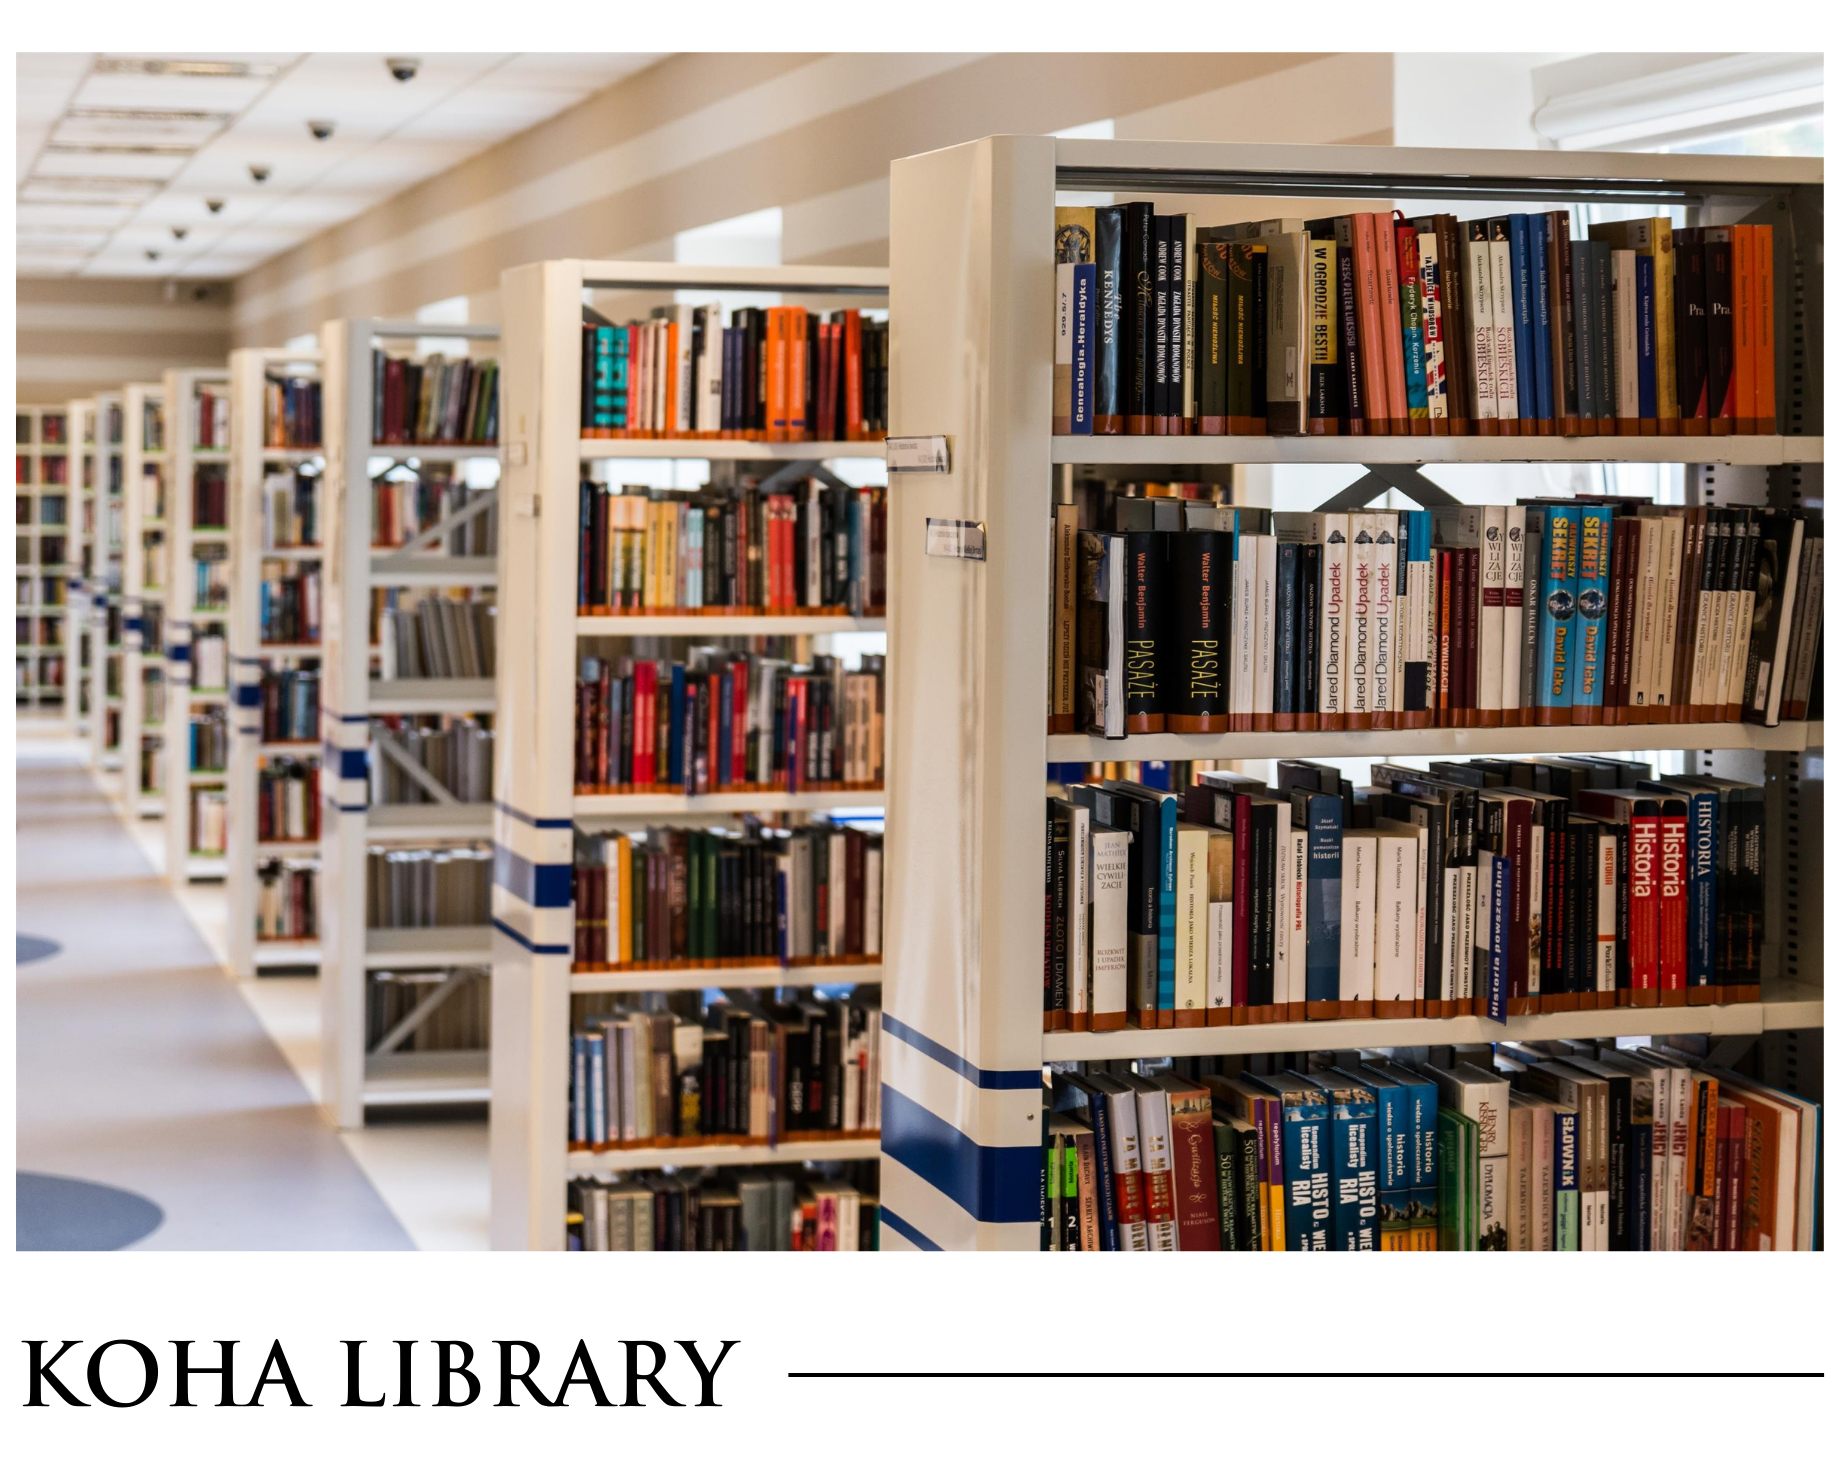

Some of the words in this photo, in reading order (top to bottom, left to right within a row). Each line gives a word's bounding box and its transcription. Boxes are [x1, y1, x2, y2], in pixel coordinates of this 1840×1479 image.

[1314, 247, 1327, 259] W
[1314, 262, 1328, 320] OGRODZIE
[1386, 268, 1394, 304] Stuartowie
[1424, 256, 1435, 292] TAJEMNICE
[1104, 270, 1113, 344] KENNEDYS
[1343, 282, 1354, 311] PIĘTER
[1407, 276, 1416, 310] Fryderyk
[1521, 283, 1529, 324] Bonapartych
[1540, 284, 1548, 325] Bonapartych
[1345, 312, 1356, 346] LUKSUSU
[1409, 312, 1419, 339] Chopin.
[1427, 297, 1437, 336] WINDSORÓW
[1076, 278, 1087, 422] Genealogia.Heraldyka
[1314, 324, 1328, 360] BESTII
[1412, 342, 1420, 375] Korzenie
[1476, 326, 1488, 399] SOBIESKICH
[1497, 326, 1509, 399] SOBIESKICH
[1488, 543, 1501, 551] WI
[1489, 552, 1500, 561] LI
[1510, 543, 1523, 552] WI
[1512, 553, 1521, 561] LI
[1550, 516, 1569, 581] SEKRET
[1567, 522, 1577, 578] NAJWIĘKSZY
[1581, 516, 1600, 581] SEKRET
[1598, 521, 1609, 578] NAJWIĘKSZY
[1137, 552, 1145, 582] Walter
[1202, 552, 1210, 582] Walter
[1486, 572, 1502, 582] CJE
[1488, 562, 1501, 571] ZA
[1508, 572, 1523, 582] CJE
[1510, 562, 1522, 571] ZA
[1327, 562, 1343, 614] Upadek
[1355, 562, 1370, 615] Upadek
[1376, 562, 1392, 614] Upadek
[1528, 579, 1537, 606] OSKAR
[1136, 585, 1147, 629] Benjamin
[1200, 585, 1211, 629] Benjamin
[1701, 592, 1709, 622] GRANICE
[1728, 592, 1737, 622] GRANICE
[1528, 608, 1537, 644] HALECKI
[1554, 626, 1568, 662] David
[1584, 625, 1599, 662] David
[1698, 624, 1706, 653] HISTORII
[1724, 624, 1733, 653] HISTORII
[1326, 617, 1339, 674] Diamond
[1354, 617, 1367, 675] Diamond
[1375, 617, 1388, 674] Diamond
[1441, 634, 1449, 693] CYWILIZACJE
[1128, 640, 1158, 699] PASAŻE
[1191, 640, 1221, 699] PASAŻE
[1553, 666, 1566, 696] Icke
[1583, 665, 1596, 694] Icke
[1326, 677, 1338, 713] Jared
[1353, 678, 1366, 713] Jared
[1374, 678, 1386, 712] Jared
[1096, 849, 1127, 857] MATHIEX
[1296, 838, 1304, 853] Rafał
[1313, 852, 1339, 860] historii
[1697, 801, 1712, 877] HISTORIA
[1096, 872, 1126, 880] CYWILI-
[1295, 853, 1303, 880] Stobiecki
[1605, 847, 1614, 885] HISTORIA
[1635, 823, 1657, 897] Historia
[1663, 823, 1685, 897] Historia
[1057, 875, 1065, 908] LIEBRICH
[1101, 881, 1122, 889] ZACJE
[1295, 881, 1303, 919] Historiografia
[1294, 919, 1302, 931] PRL
[1493, 861, 1503, 954] powszechna
[1095, 963, 1126, 971] IMPERIÓW
[1491, 957, 1500, 1018] Historia
[1386, 1101, 1394, 1126] wiedza
[1416, 1098, 1424, 1123] wiedza
[1708, 1088, 1717, 1127] HISTORIA
[1123, 1135, 1137, 1152] ZA
[1149, 1135, 1165, 1152] ZA
[1272, 1122, 1281, 1166] repetytorium
[1479, 1101, 1489, 1153] KISSINGER
[1488, 1109, 1497, 1145] HENRY
[1188, 1134, 1203, 1189] Cywilizacja
[1220, 1154, 1232, 1169] 50
[1244, 1139, 1254, 1154] 50
[1300, 1126, 1312, 1170] licealisty
[1310, 1125, 1320, 1169] Kompendium
[1347, 1124, 1359, 1168] licealisty
[1358, 1123, 1367, 1168] Kompendium
[1386, 1133, 1394, 1186] społeczeństwie
[1396, 1133, 1406, 1176] historia
[1415, 1131, 1424, 1183] społeczeństwie
[1425, 1131, 1434, 1173] historia
[1705, 1128, 1716, 1192] POWSZECHNA
[1083, 1162, 1091, 1185] DECAUX
[1124, 1157, 1140, 1209] MINUTĘ
[1150, 1157, 1169, 1209] MINUTĘ
[1340, 1178, 1358, 1204] RIA
[1292, 1180, 1311, 1206] RIA
[1312, 1172, 1329, 1219] HISTO
[1359, 1170, 1376, 1217] HISTO
[1483, 1164, 1494, 1220] DYPLOMACJA
[1068, 1215, 1076, 1227] 2
[1183, 1217, 1215, 1226] FERGUSON
[1190, 1211, 1208, 1219] NIALL
[1520, 1222, 1526, 1236] XX
[1543, 1221, 1549, 1234] XX
[1312, 1229, 1326, 1252] WIE
